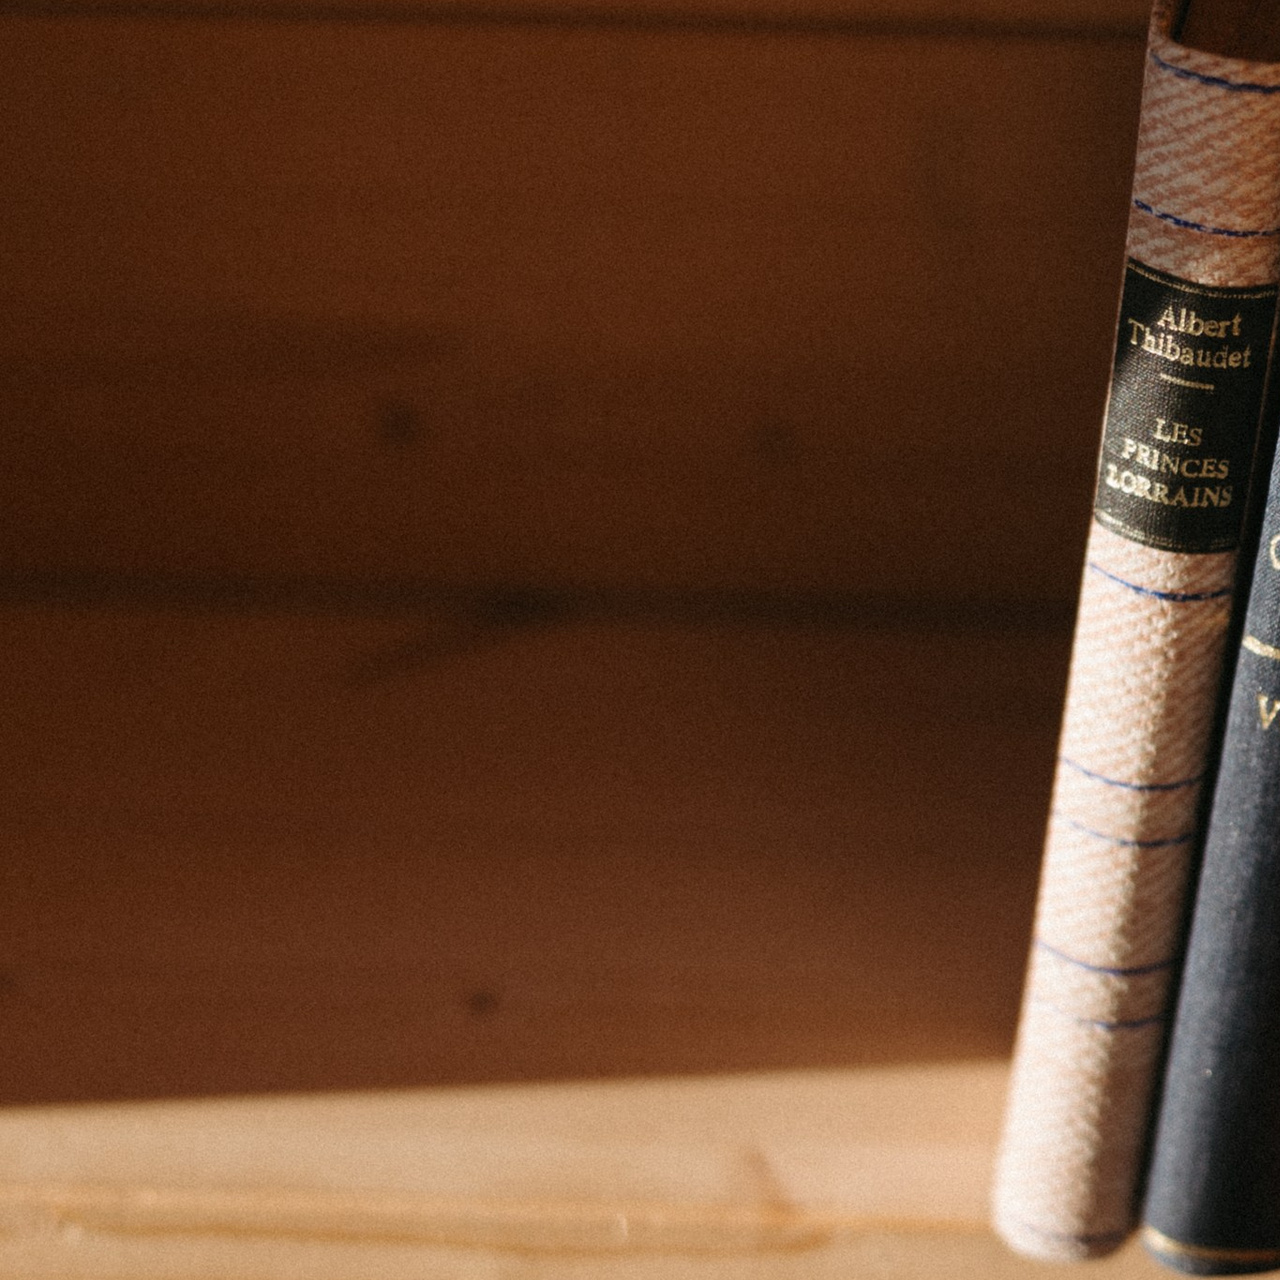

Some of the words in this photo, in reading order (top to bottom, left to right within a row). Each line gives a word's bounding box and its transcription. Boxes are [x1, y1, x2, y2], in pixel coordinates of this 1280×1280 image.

[1157, 305, 1242, 338] Albert
[1127, 318, 1252, 369] Thibaudet
[1154, 419, 1203, 447] LES
[1121, 438, 1230, 480] PRINCES
[1105, 464, 1233, 508] LORRAINS
